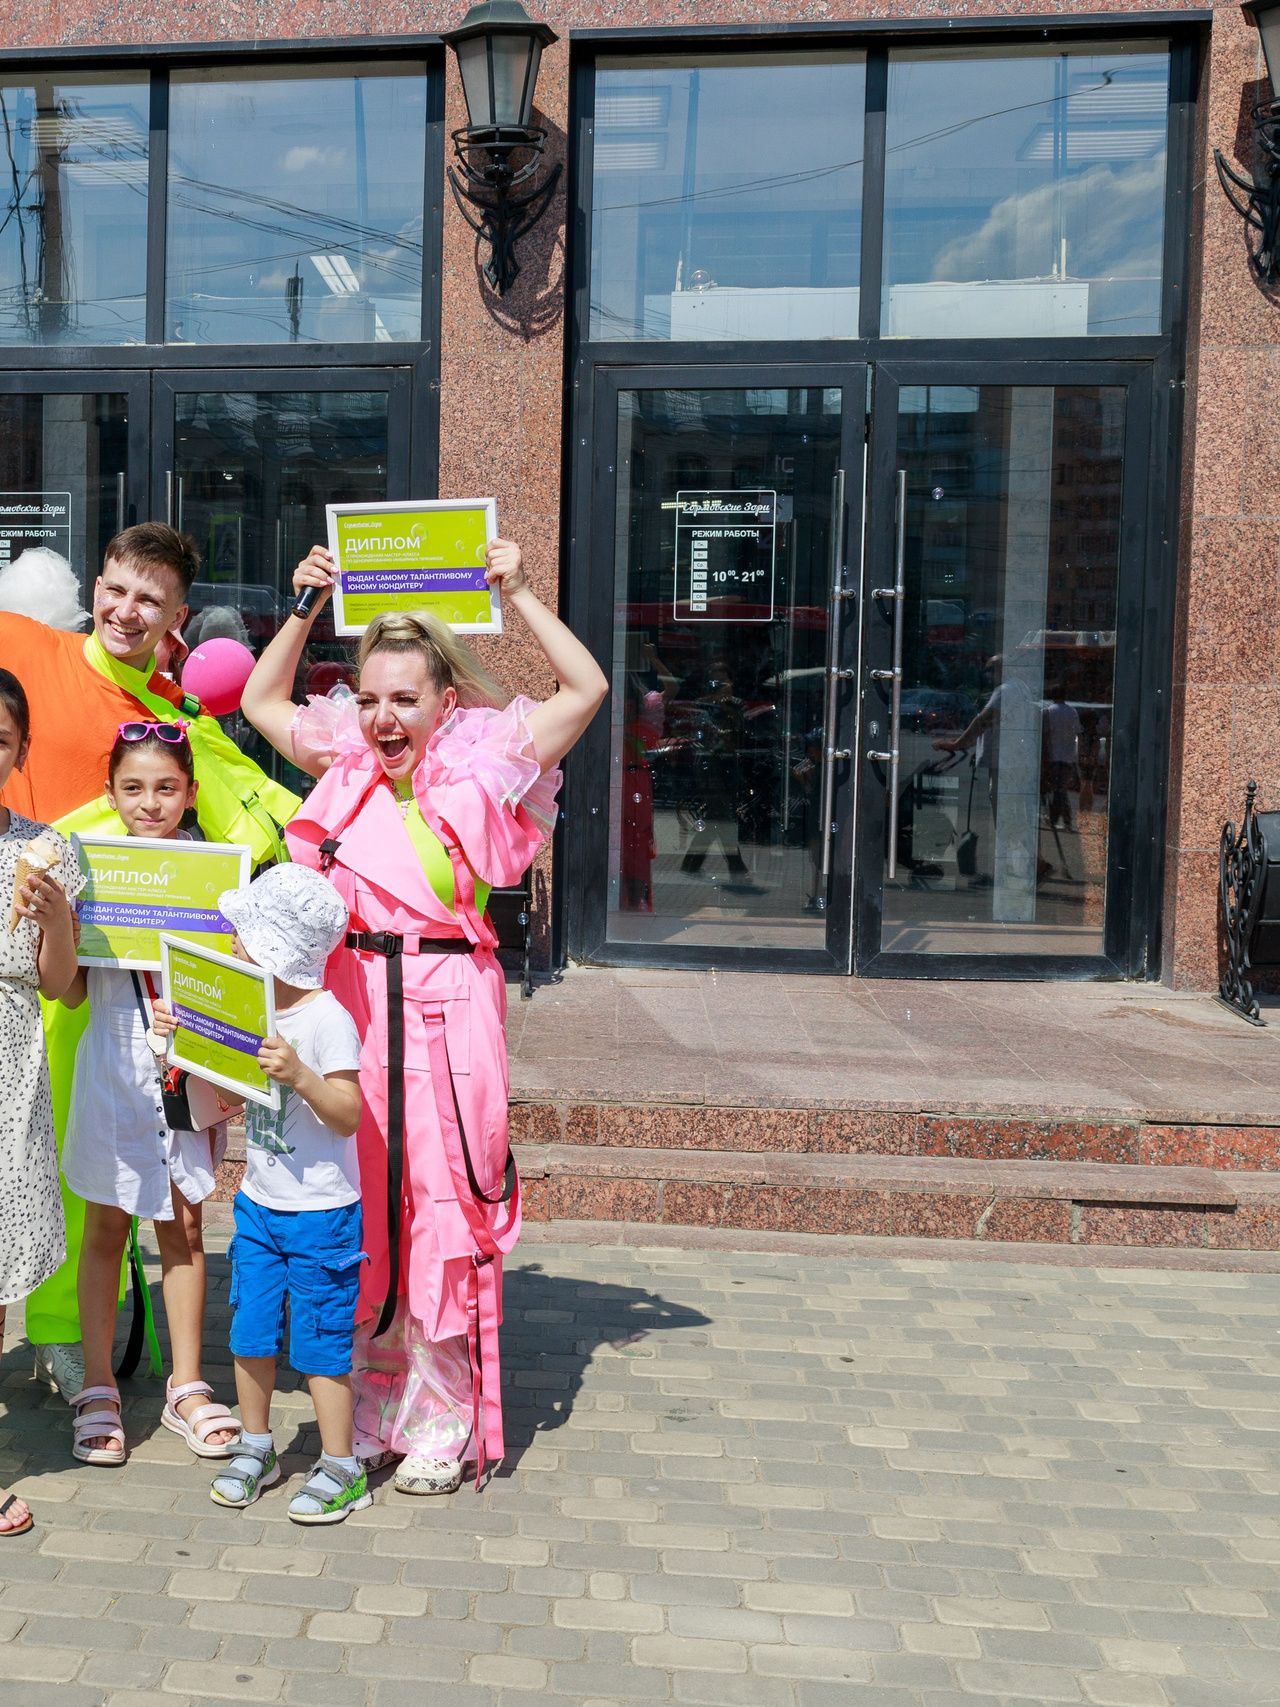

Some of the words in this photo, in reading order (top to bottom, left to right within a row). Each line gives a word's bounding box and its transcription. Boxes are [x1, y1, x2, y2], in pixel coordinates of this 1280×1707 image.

[42, 504, 66, 517] Зори
[682, 503, 742, 517] Сормовские
[743, 502, 770, 517] Зори
[345, 536, 421, 554] ДИПЛОМ
[347, 574, 374, 583] ВЫДАН
[375, 573, 408, 582] САМОМУ
[410, 572, 473, 581] ТАЛАНТЛИВОМУ
[347, 583, 377, 591] ЮНОМУ
[378, 582, 424, 590] КОНДИТЕРУ
[87, 868, 169, 887] ДИПЛОМ
[82, 904, 113, 914] ВЫДАН
[114, 906, 151, 917] САМОМУ
[152, 909, 220, 921] ТАЛАНТЛИВОМУ
[82, 913, 115, 922] ЮНОМУ
[116, 916, 166, 926] КОНДИТЕРУ
[173, 971, 222, 1001] ДИПЛОМ
[174, 1006, 193, 1020] ВЫДАН
[193, 1013, 215, 1030] САМОМУ
[215, 1023, 258, 1046] ТАЛАНТЛИВОМУ
[195, 1021, 225, 1041] КОНДИТЕРУ
